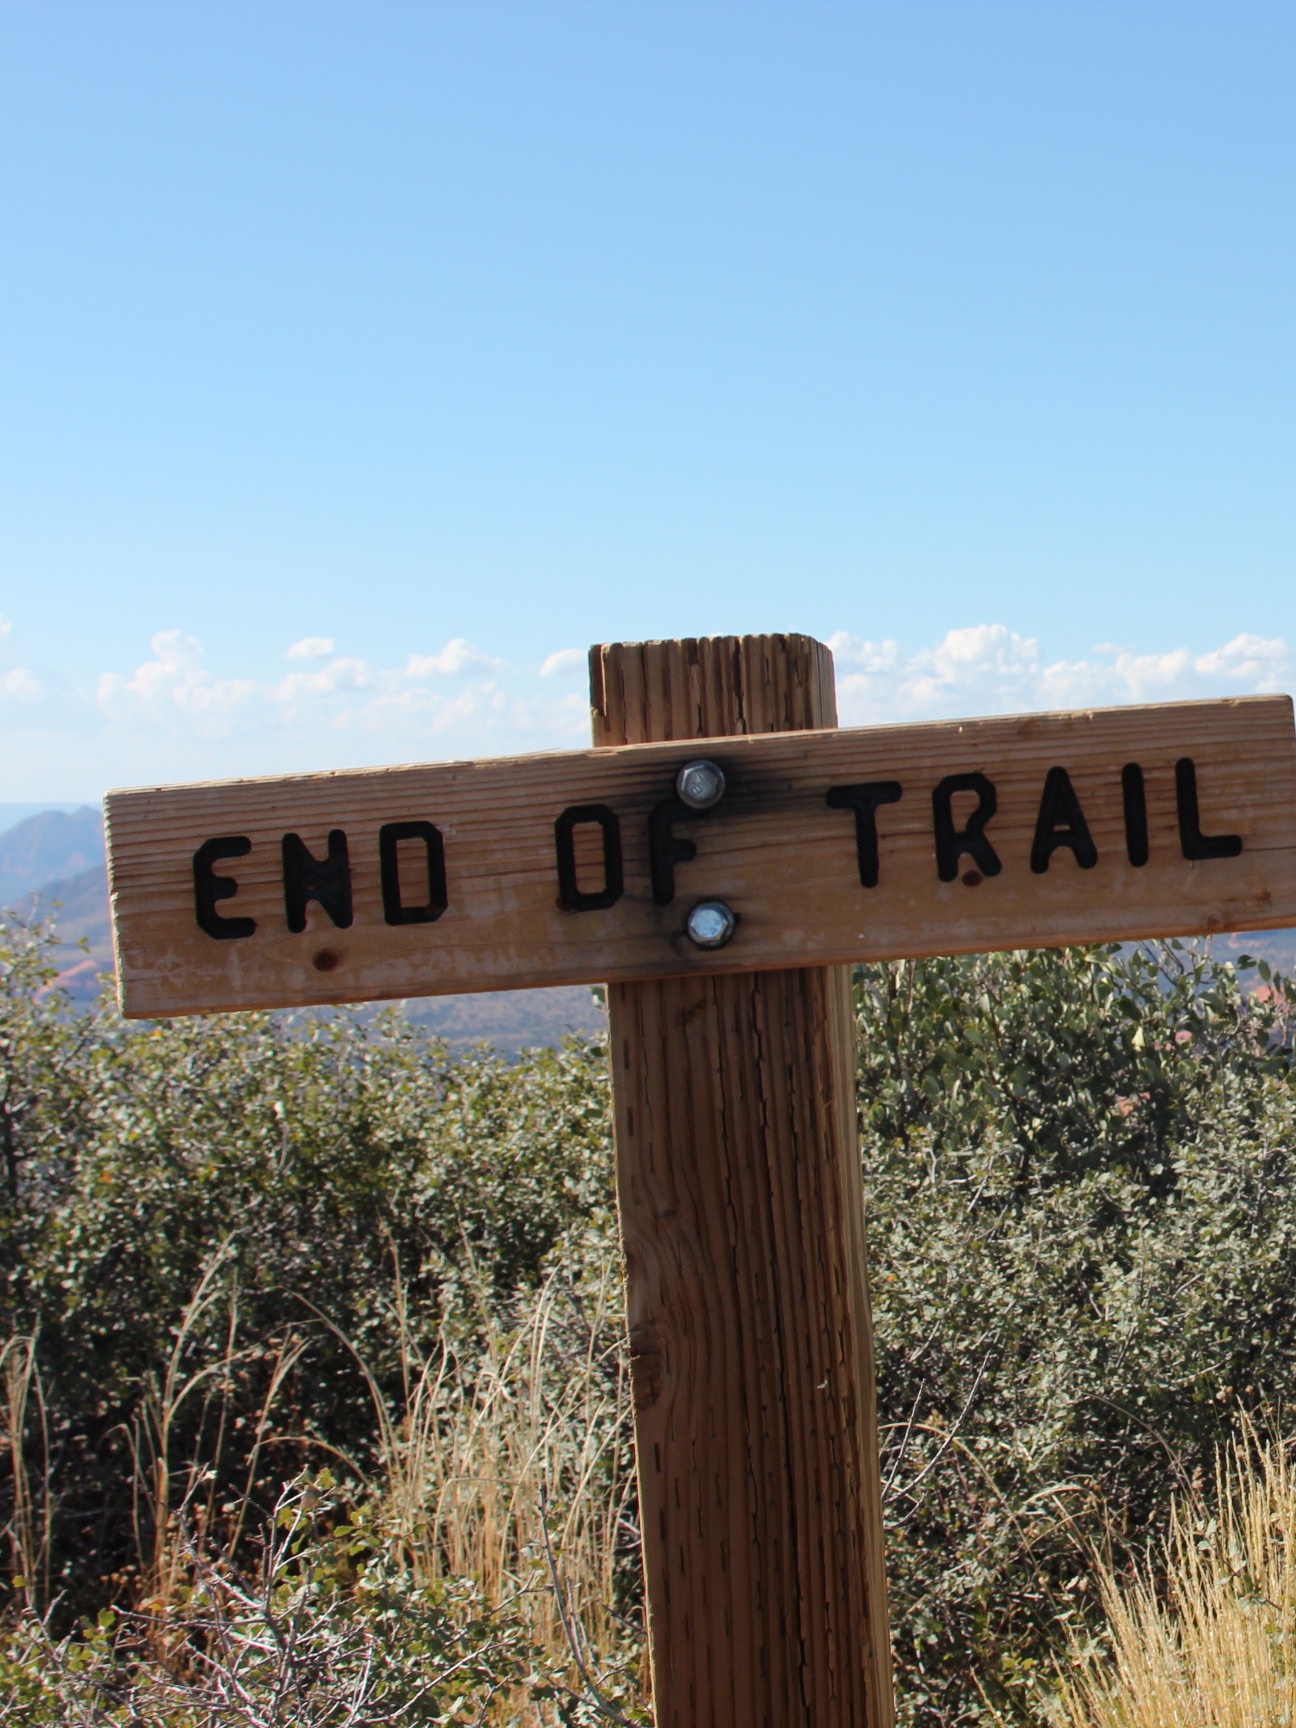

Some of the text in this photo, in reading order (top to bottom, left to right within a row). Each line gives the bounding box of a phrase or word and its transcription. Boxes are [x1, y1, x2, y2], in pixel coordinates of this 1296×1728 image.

[193, 757, 1243, 940] END OF TRAIL
